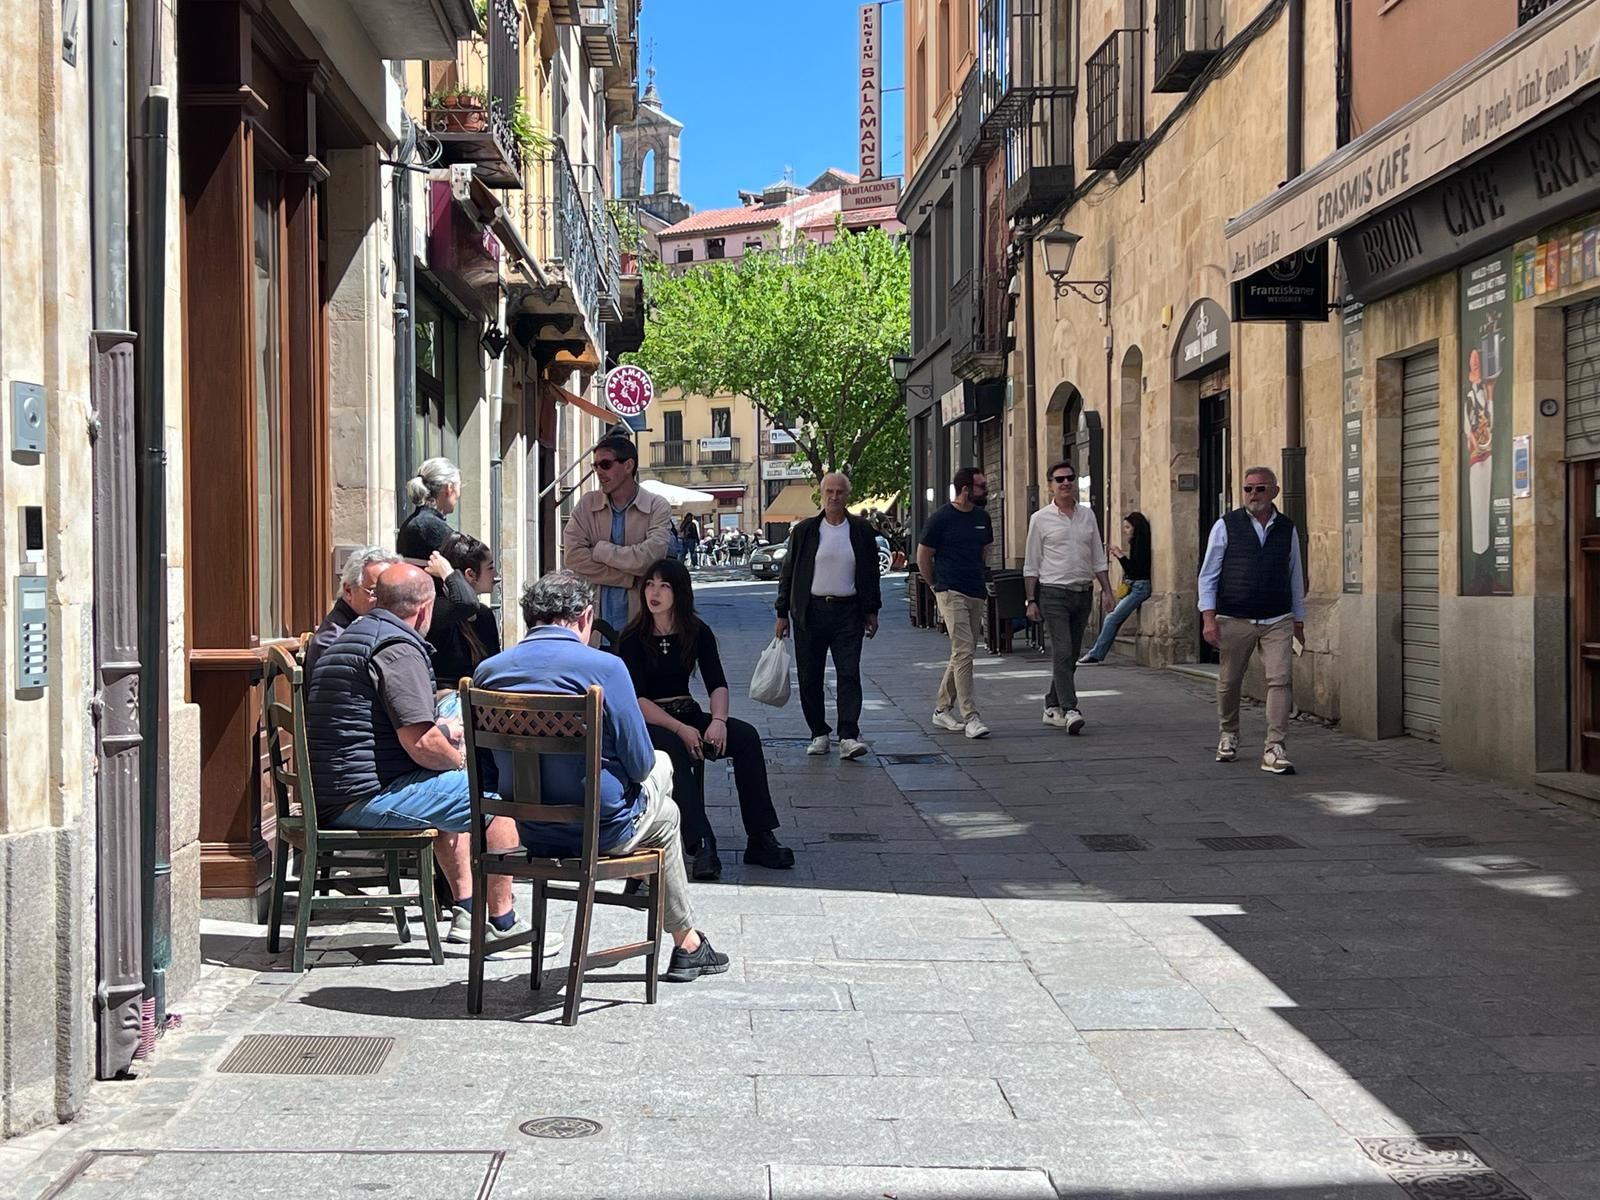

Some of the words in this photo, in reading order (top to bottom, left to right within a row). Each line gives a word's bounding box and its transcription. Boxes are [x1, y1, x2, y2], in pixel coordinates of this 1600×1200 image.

[860, 67, 876, 178] SALAMANCA
[841, 181, 896, 196] HABITACIONES
[1317, 165, 1373, 231] ERASMUS
[1377, 131, 1410, 196] CAFÉ
[855, 195, 882, 206] ROOMS
[1361, 207, 1422, 275] BRUIN
[1250, 284, 1316, 297] Franziskaner
[609, 369, 651, 397] SALAMANCA
[612, 399, 641, 413] COFFEE
